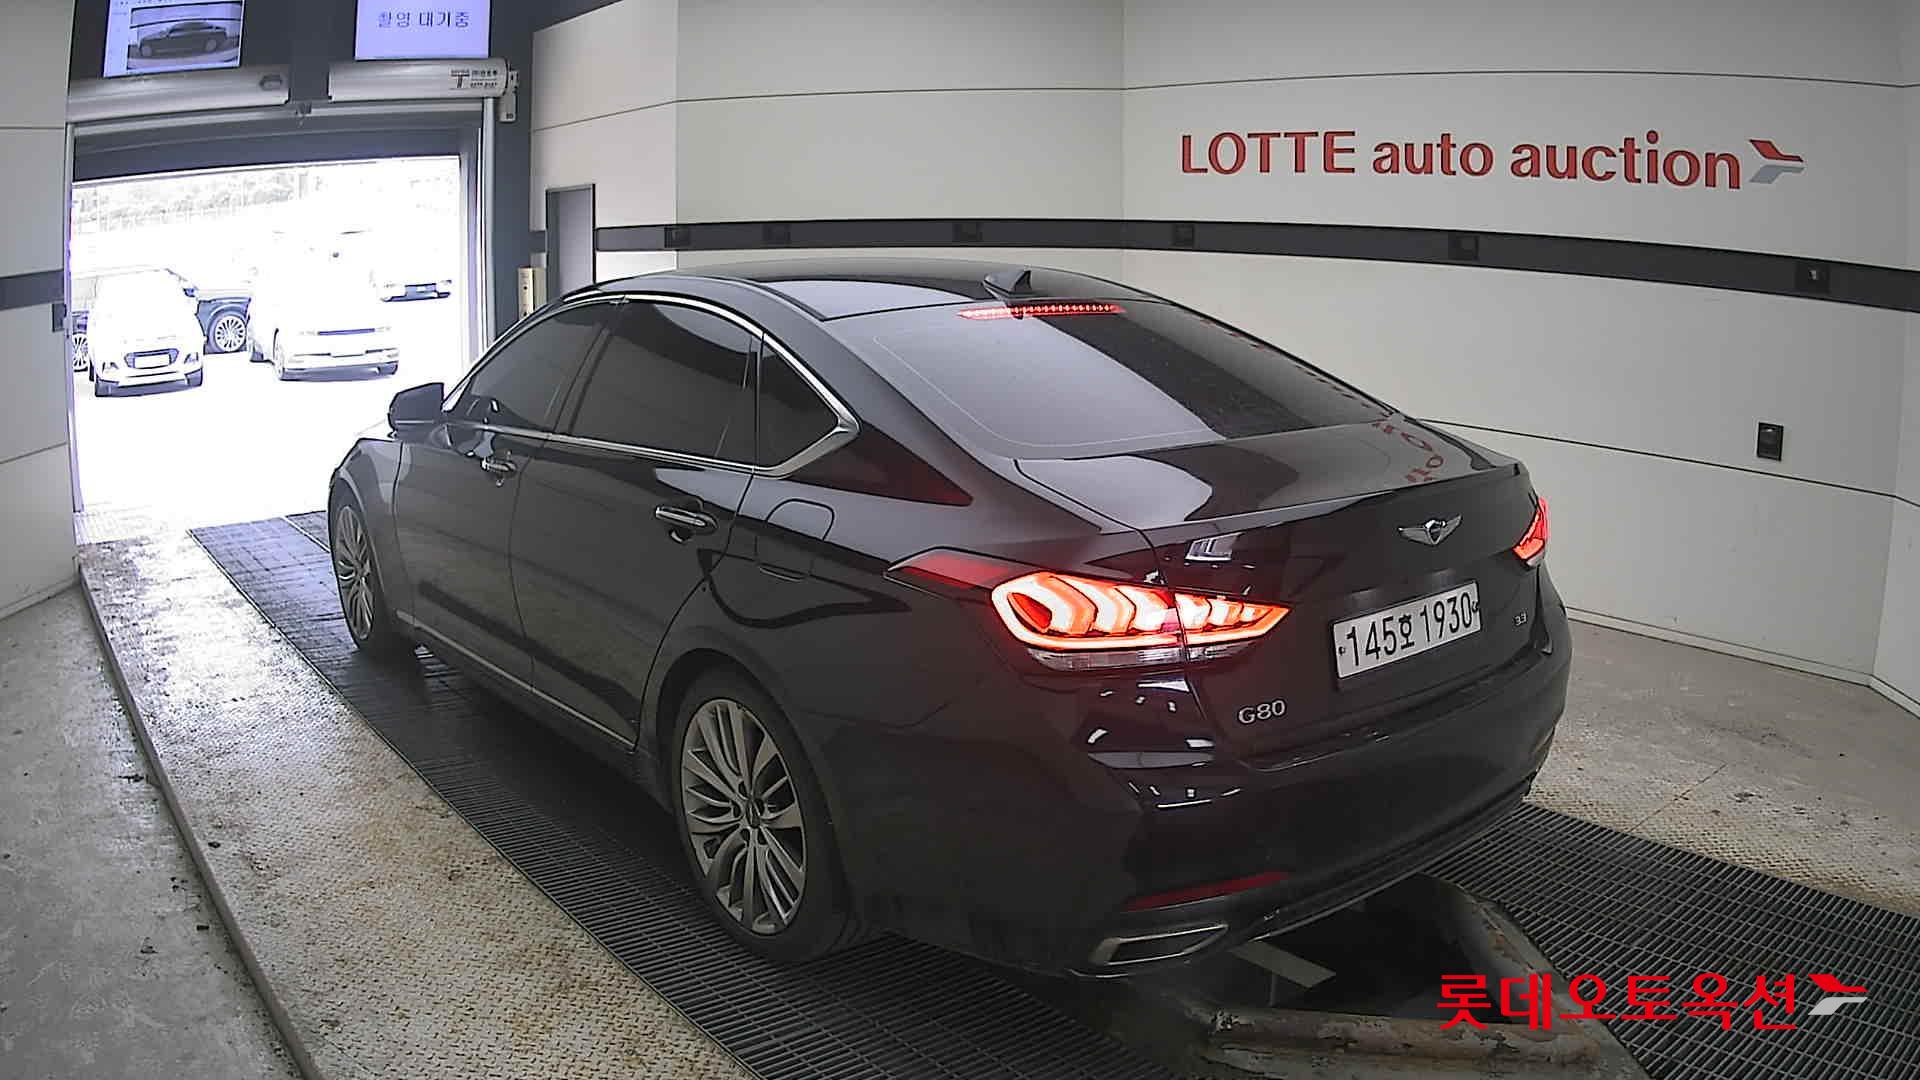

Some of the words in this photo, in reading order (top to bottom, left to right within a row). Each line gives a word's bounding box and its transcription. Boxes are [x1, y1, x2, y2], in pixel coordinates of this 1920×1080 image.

[419, 11, 470, 28] 대기중
[1181, 131, 1355, 174] LOTTE
[1373, 134, 1494, 177] auto
[1511, 130, 1741, 188] auction
[1346, 614, 1415, 666] 145호
[1420, 592, 1473, 643] 1930
[1238, 699, 1286, 724] G80
